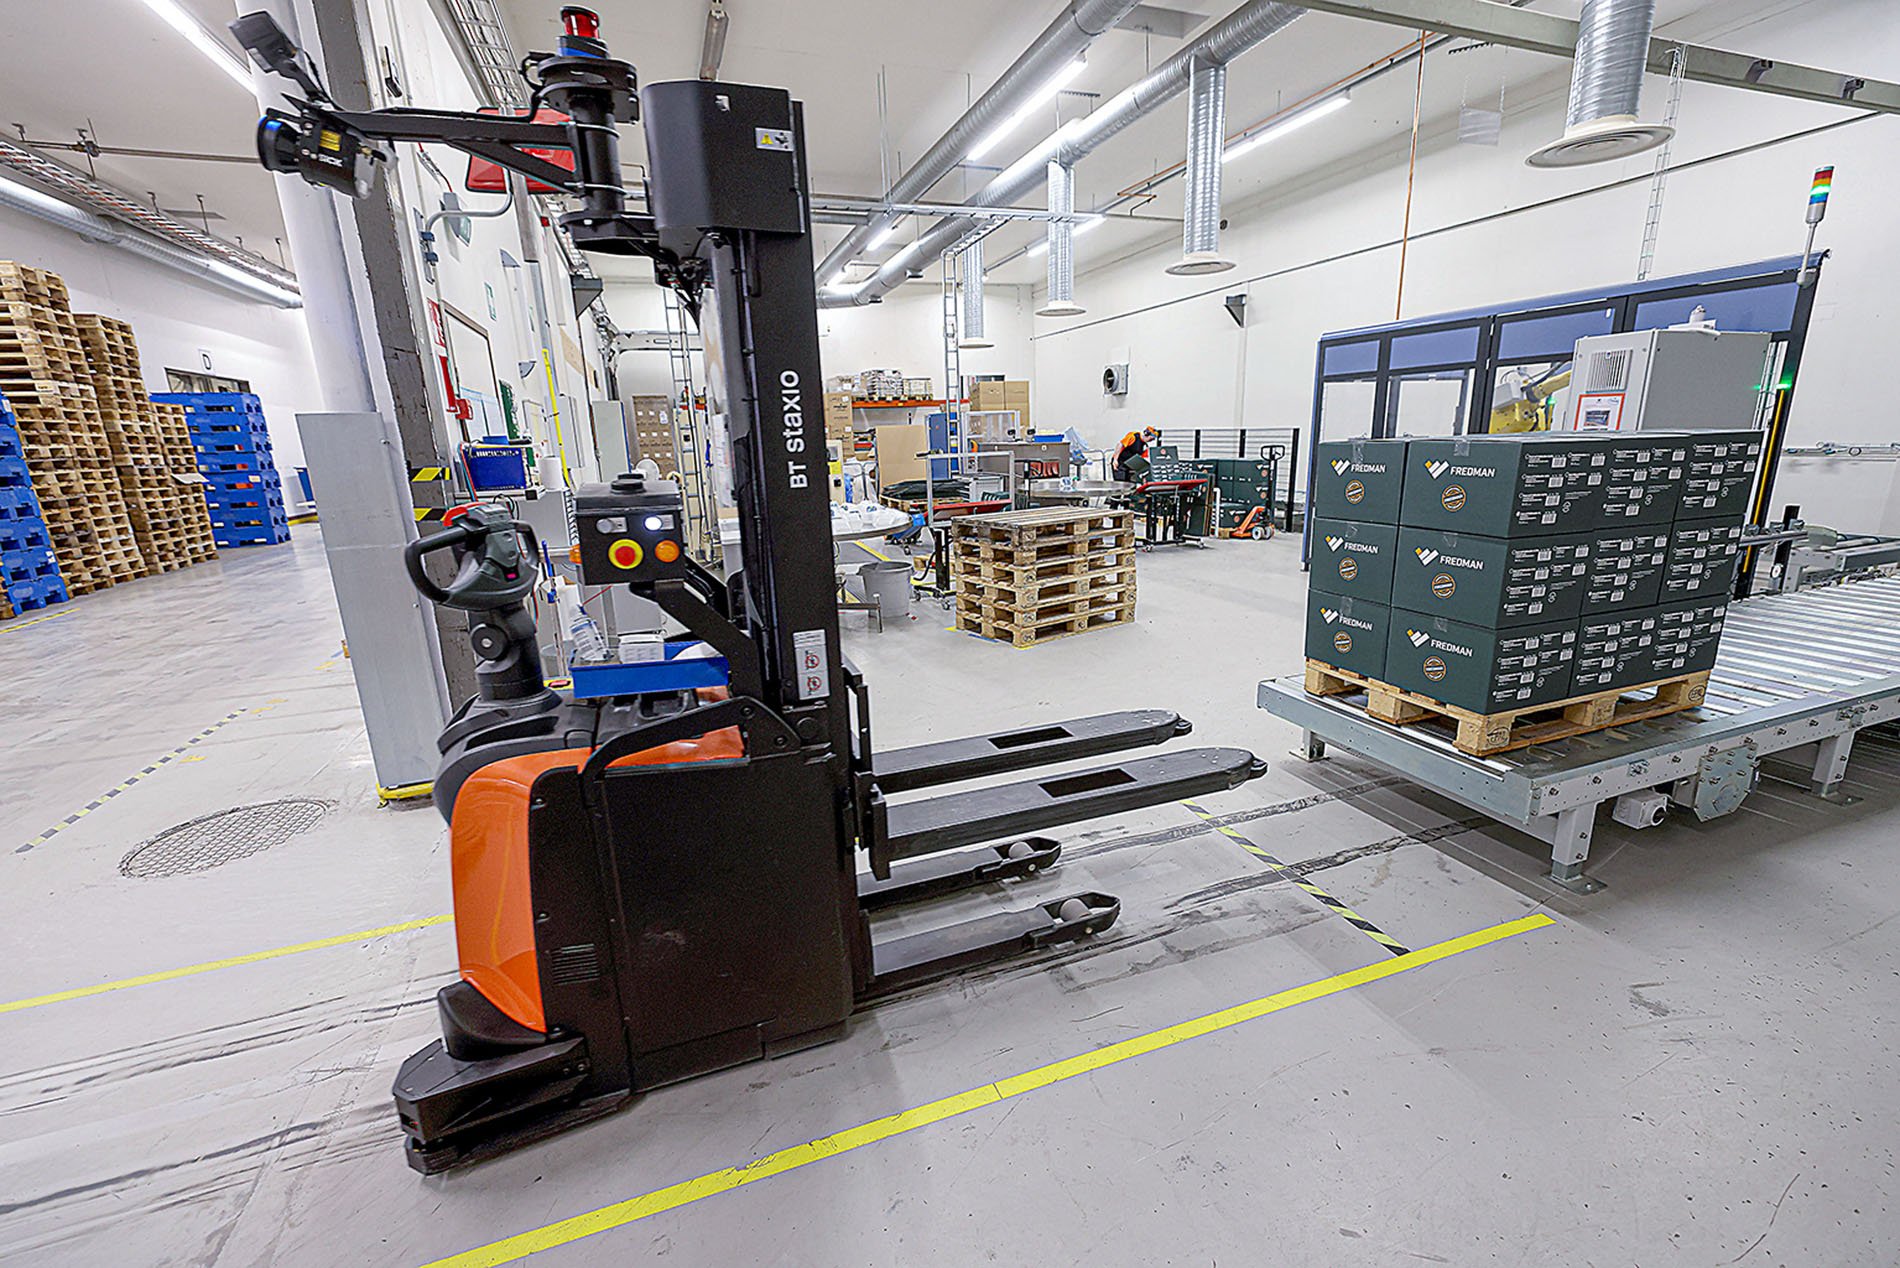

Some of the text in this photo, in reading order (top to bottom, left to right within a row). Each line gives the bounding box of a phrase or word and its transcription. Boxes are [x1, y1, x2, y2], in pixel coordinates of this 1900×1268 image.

[202, 353, 212, 370] D
[787, 461, 808, 488] BT
[1351, 463, 1386, 473] FREDMAN
[1450, 466, 1496, 477] FREDMAN
[1344, 541, 1378, 554] FREDMAN
[1439, 555, 1484, 570] FREDMAN
[1338, 615, 1373, 631] FREDMAN
[1430, 639, 1473, 657] FREDMAN
